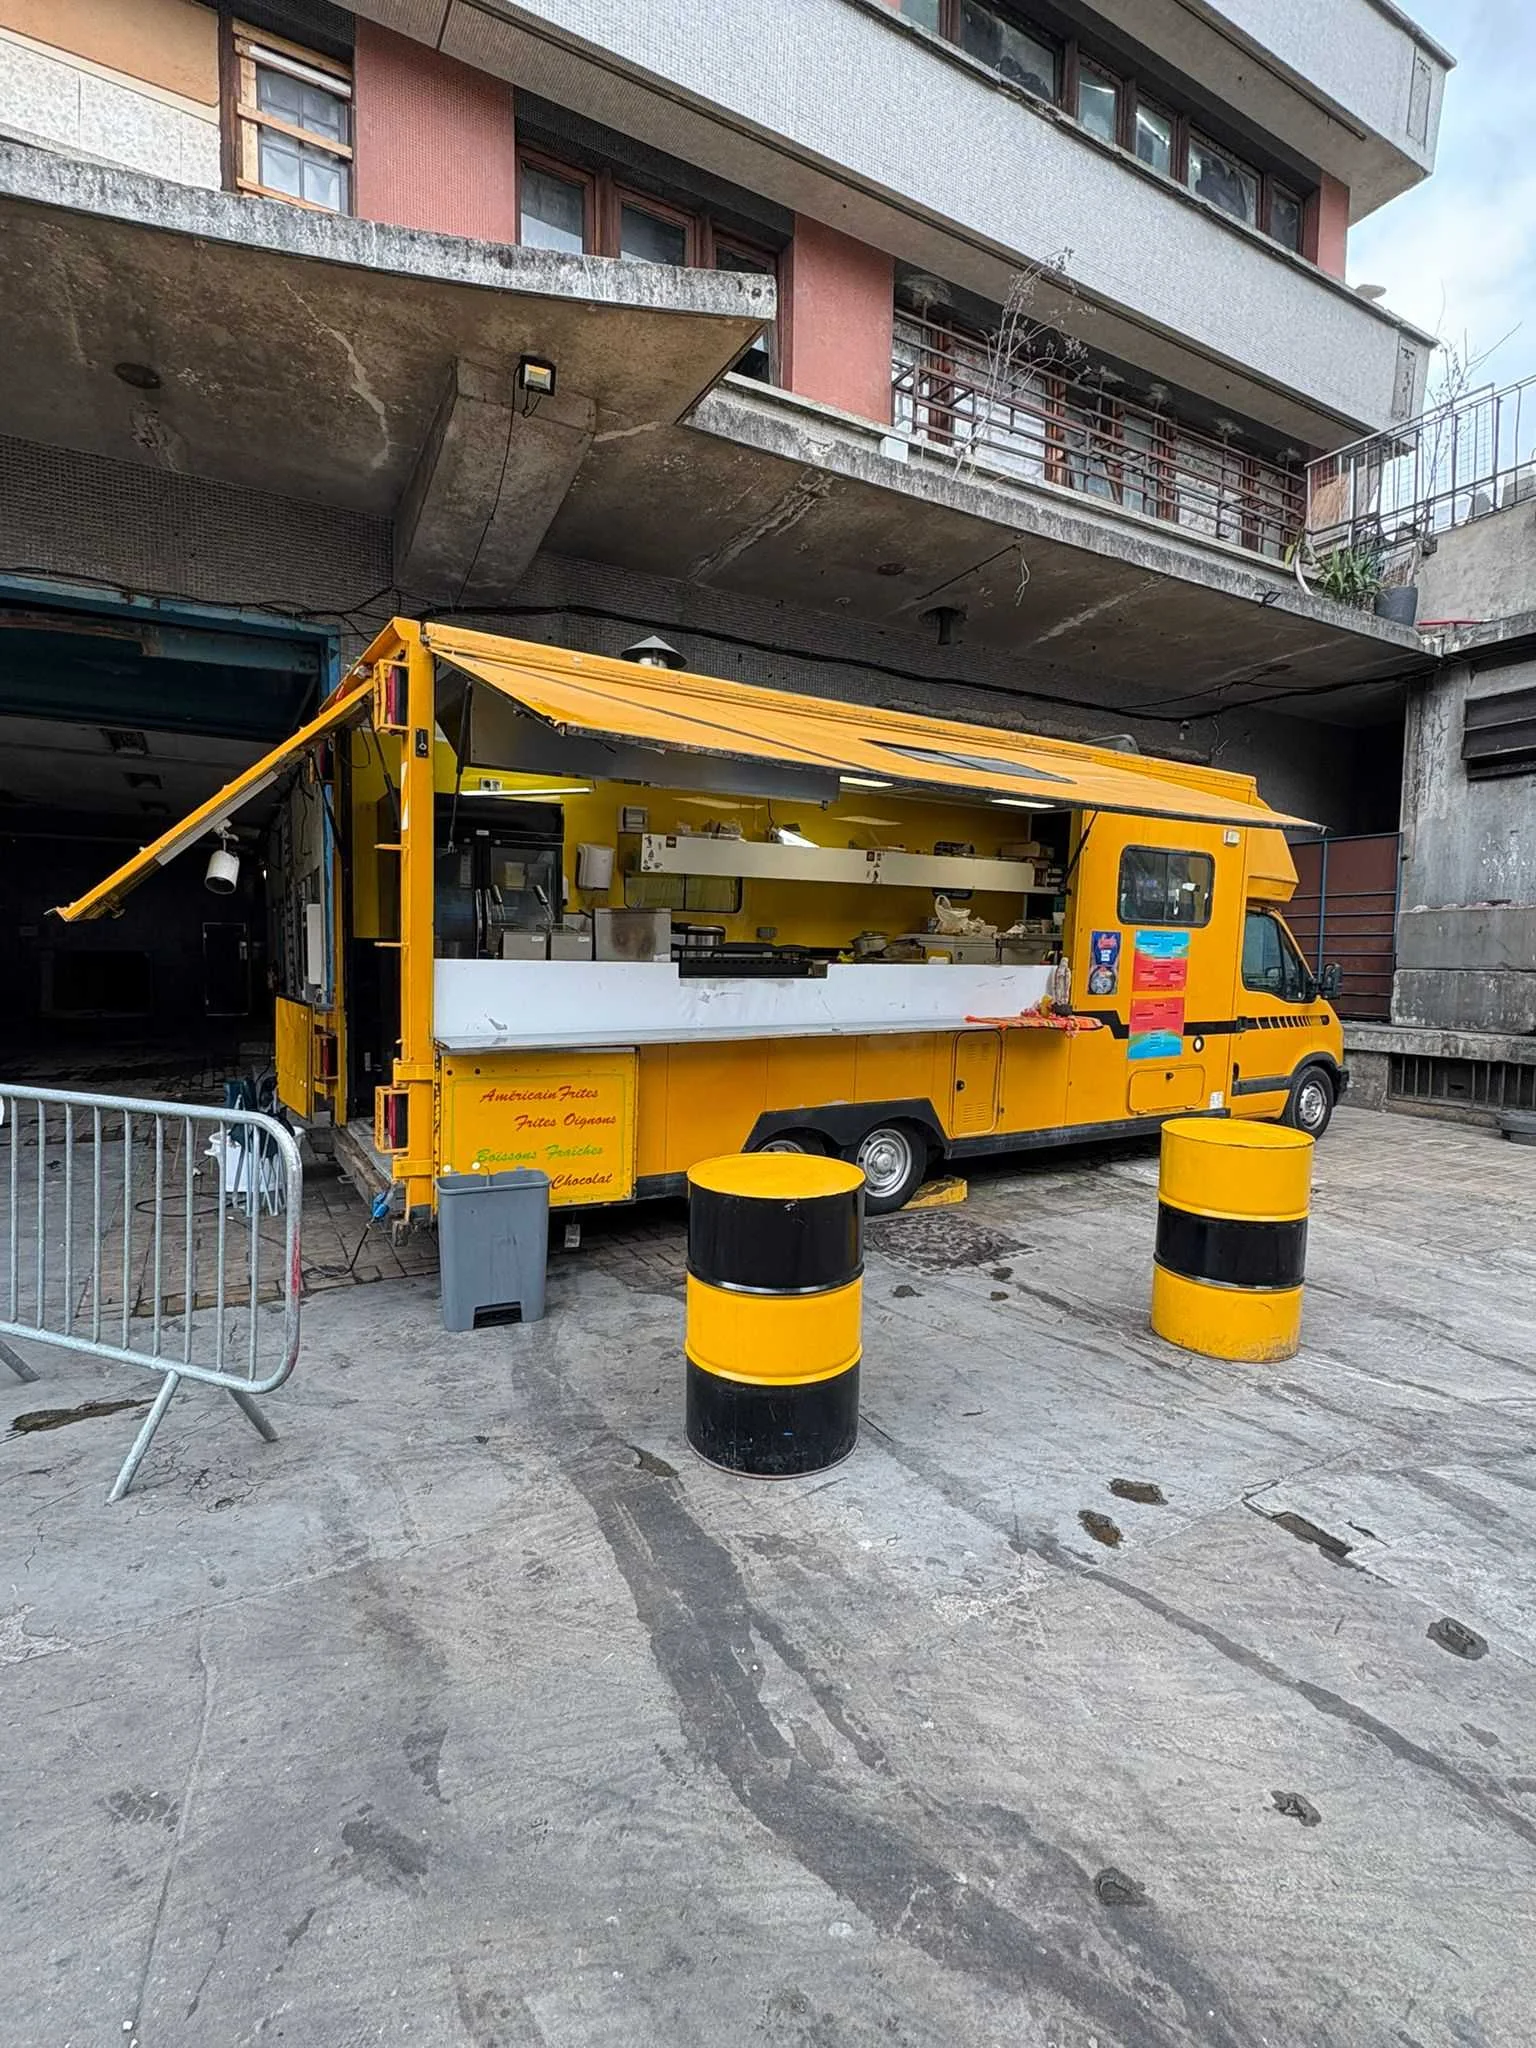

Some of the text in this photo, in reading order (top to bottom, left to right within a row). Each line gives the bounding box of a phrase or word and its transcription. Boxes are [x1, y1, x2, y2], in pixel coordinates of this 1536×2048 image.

[480, 1085, 599, 1103] Américain Frites
[513, 1113, 617, 1131] Frites Oignons
[476, 1148, 537, 1162] Boissons
[551, 1172, 613, 1190] Chocolat
